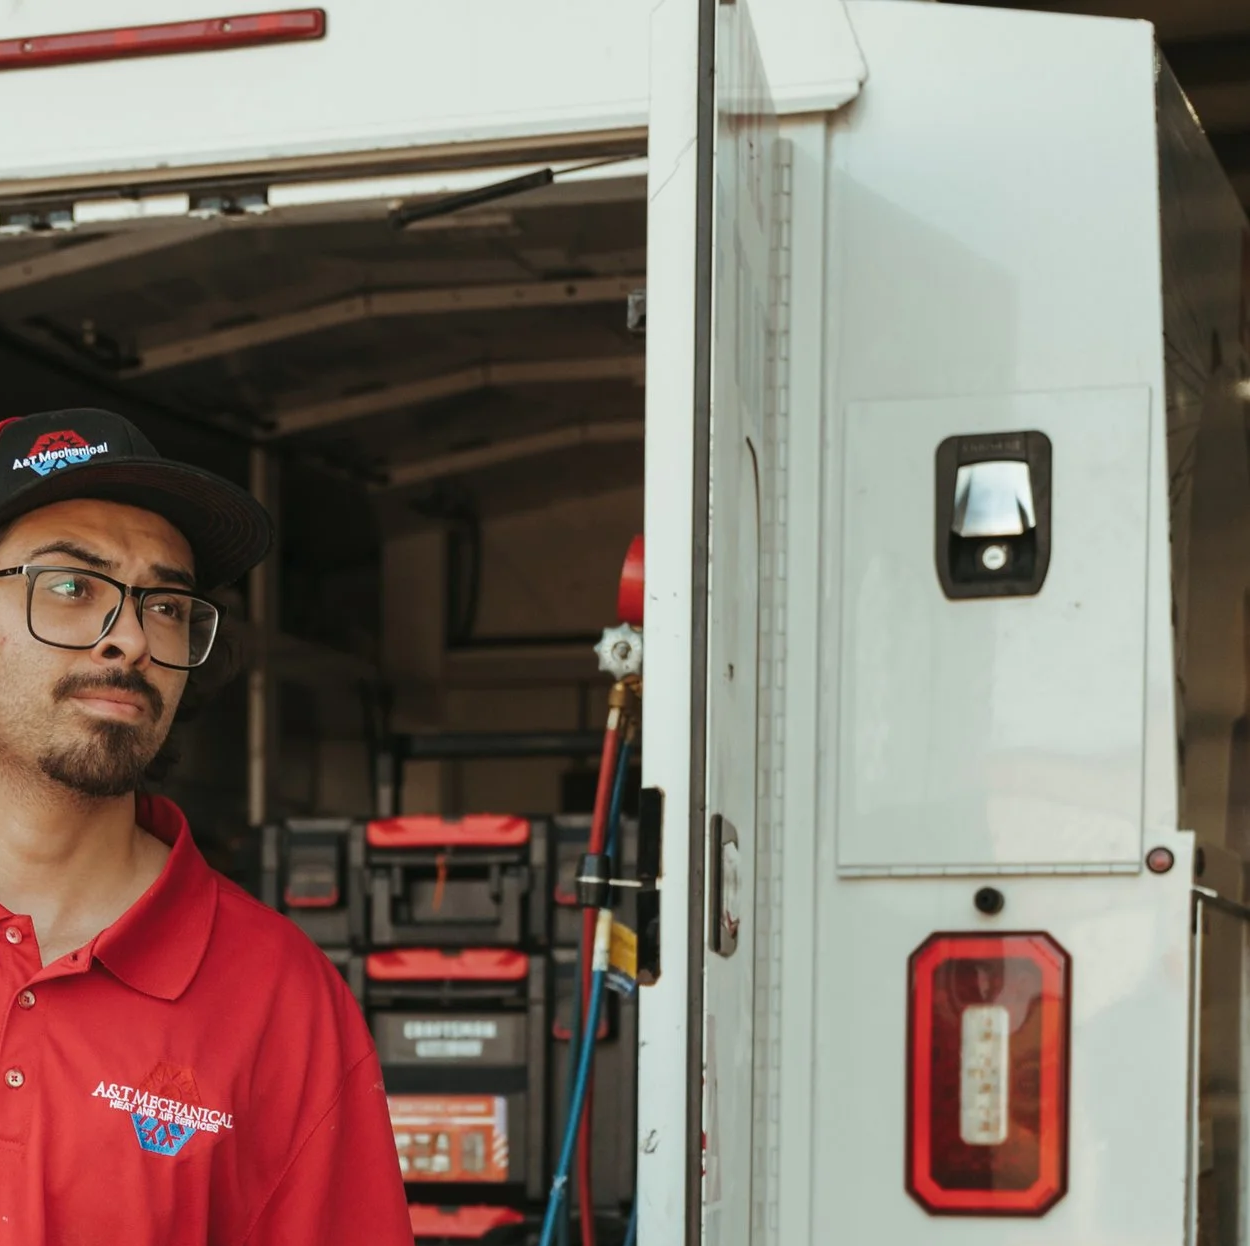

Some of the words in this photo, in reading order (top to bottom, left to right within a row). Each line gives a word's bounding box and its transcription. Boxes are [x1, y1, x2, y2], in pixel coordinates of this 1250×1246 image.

[12, 455, 37, 470] A&T
[38, 442, 109, 463] Mechanical
[91, 1081, 133, 1101] A&T
[133, 1089, 234, 1129] MECHANICAL
[109, 1100, 135, 1113] HEAT
[136, 1106, 156, 1118] AND
[158, 1111, 173, 1122] AIR
[174, 1115, 219, 1133] SERVICES
